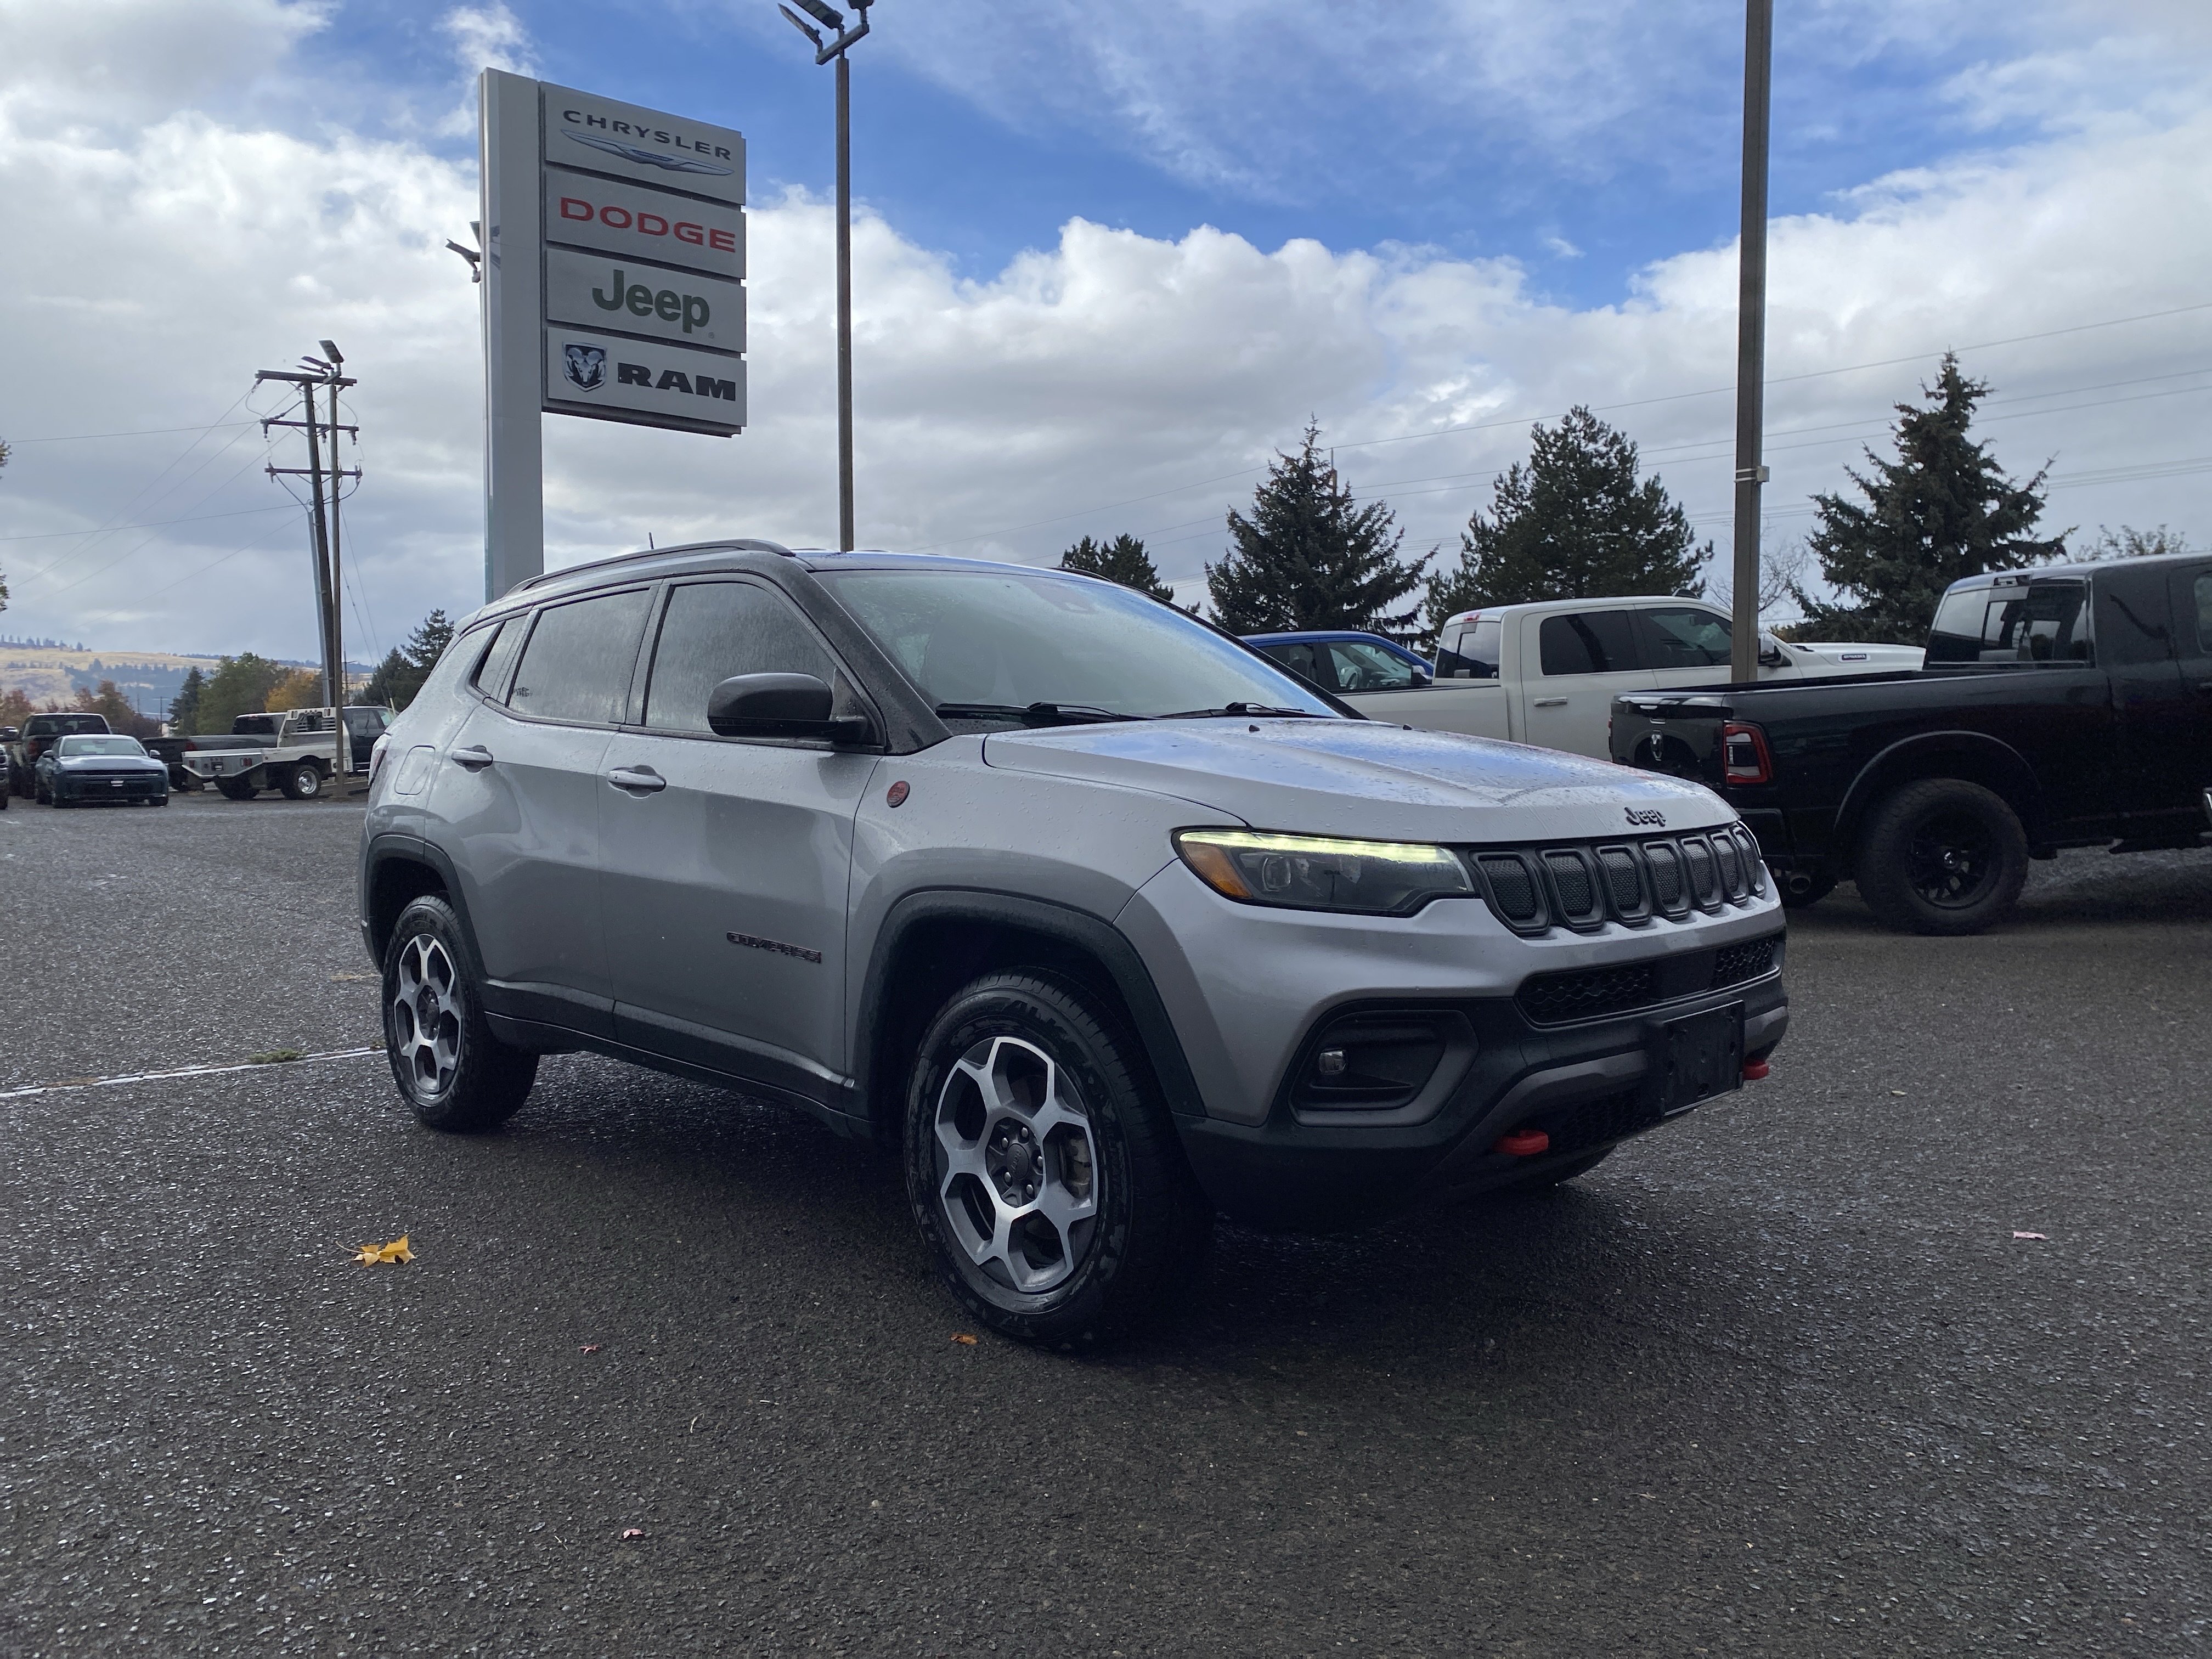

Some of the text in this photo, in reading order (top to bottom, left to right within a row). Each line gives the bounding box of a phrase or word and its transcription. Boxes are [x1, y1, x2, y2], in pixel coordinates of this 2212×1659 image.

[563, 110, 730, 160] CHRYSLER
[560, 197, 736, 253] DODGE
[592, 270, 710, 333] Jeep
[617, 362, 736, 401] RAM
[1624, 807, 1666, 827] Jeep
